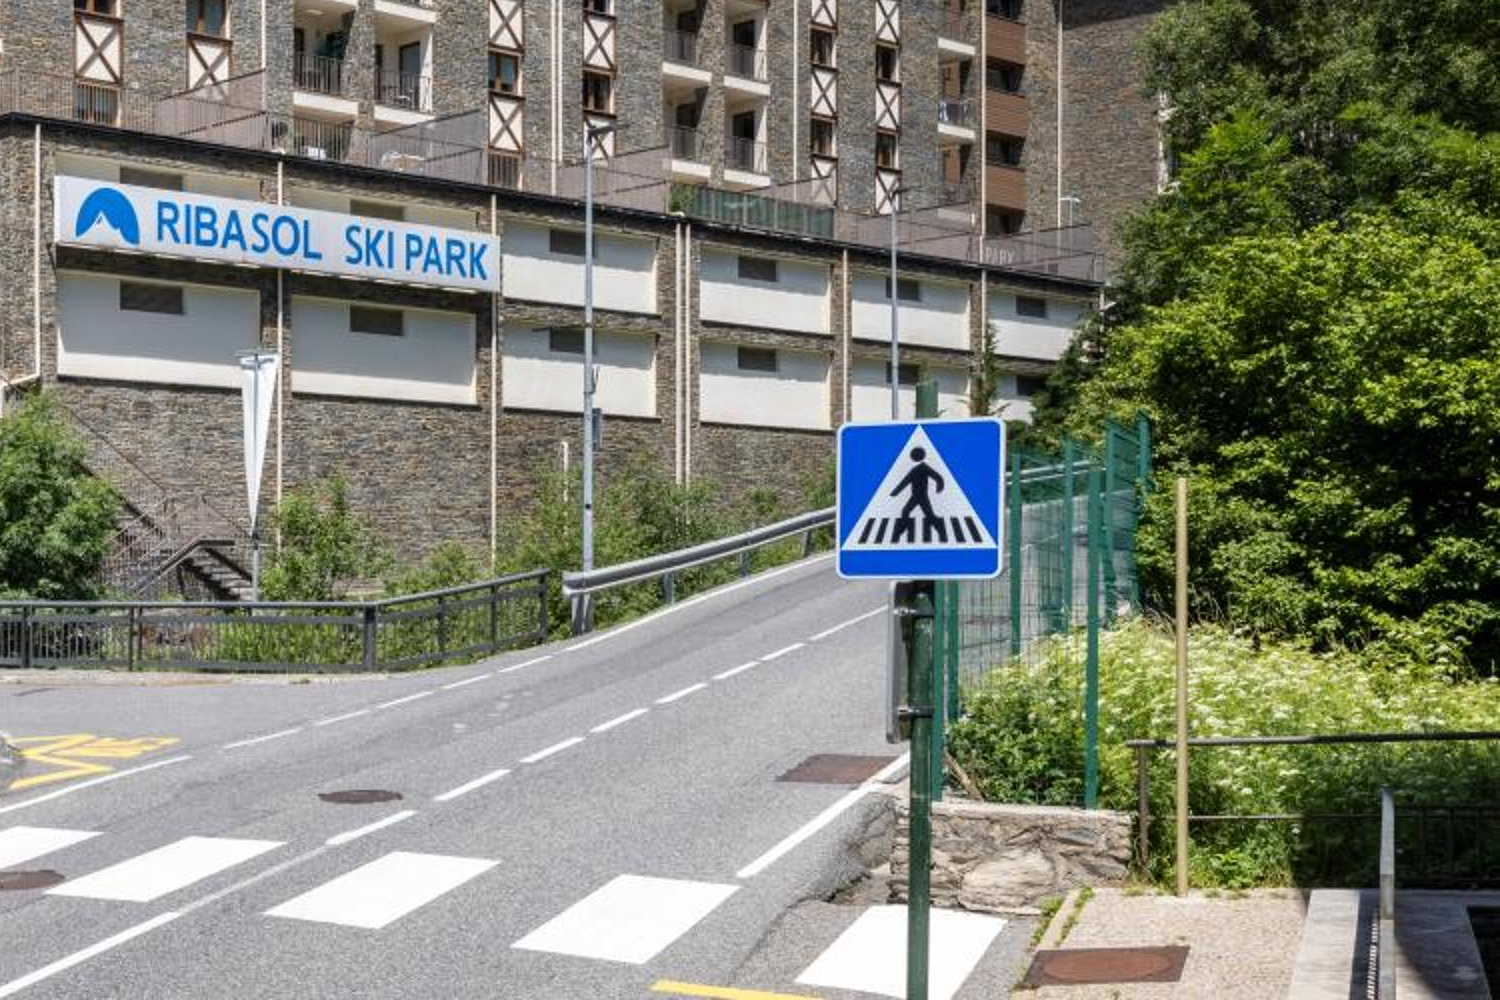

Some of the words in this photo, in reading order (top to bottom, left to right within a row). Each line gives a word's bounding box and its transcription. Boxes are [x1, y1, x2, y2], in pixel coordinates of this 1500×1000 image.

[156, 201, 323, 261] RIBASOL
[344, 224, 395, 269] SKI
[404, 233, 488, 280] PARK
